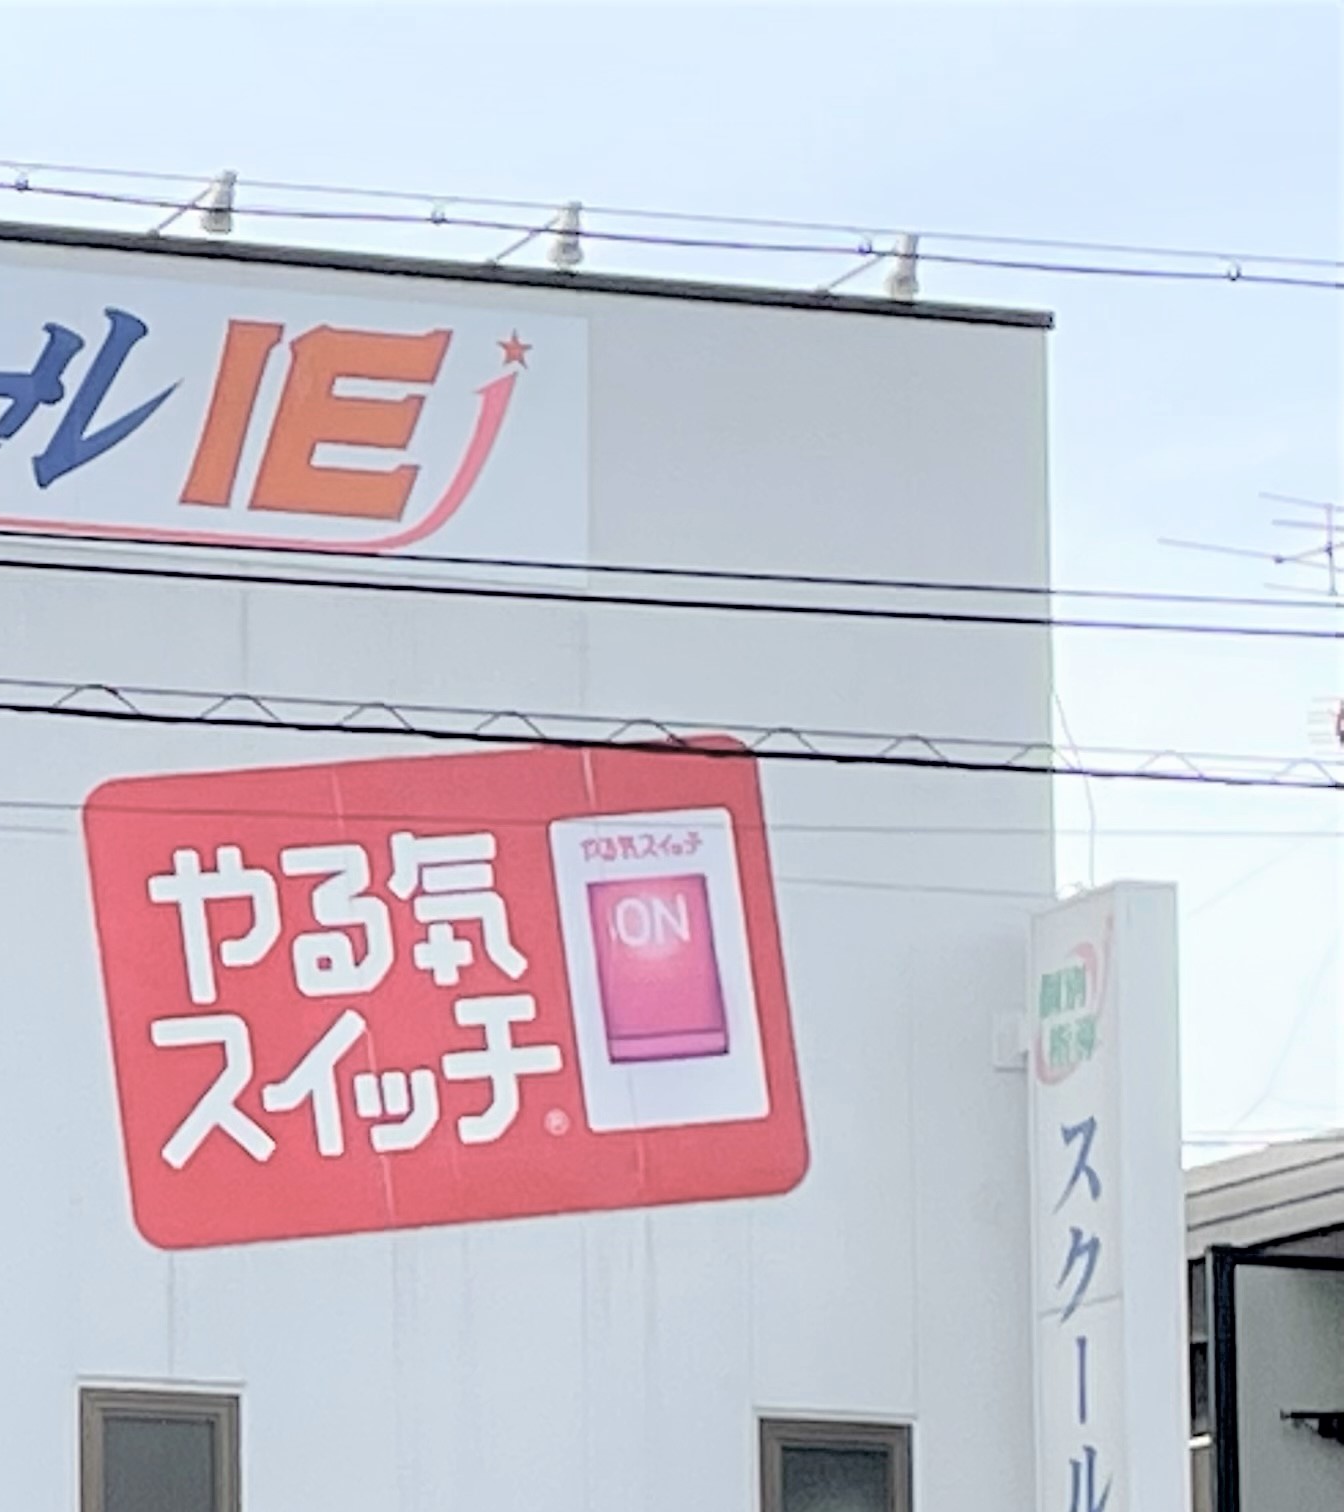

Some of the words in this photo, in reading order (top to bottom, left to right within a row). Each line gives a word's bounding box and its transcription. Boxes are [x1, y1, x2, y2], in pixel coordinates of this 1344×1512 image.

[148, 831, 527, 1004] やる気
[613, 893, 690, 947] ON
[150, 995, 562, 1169] スイッチ
